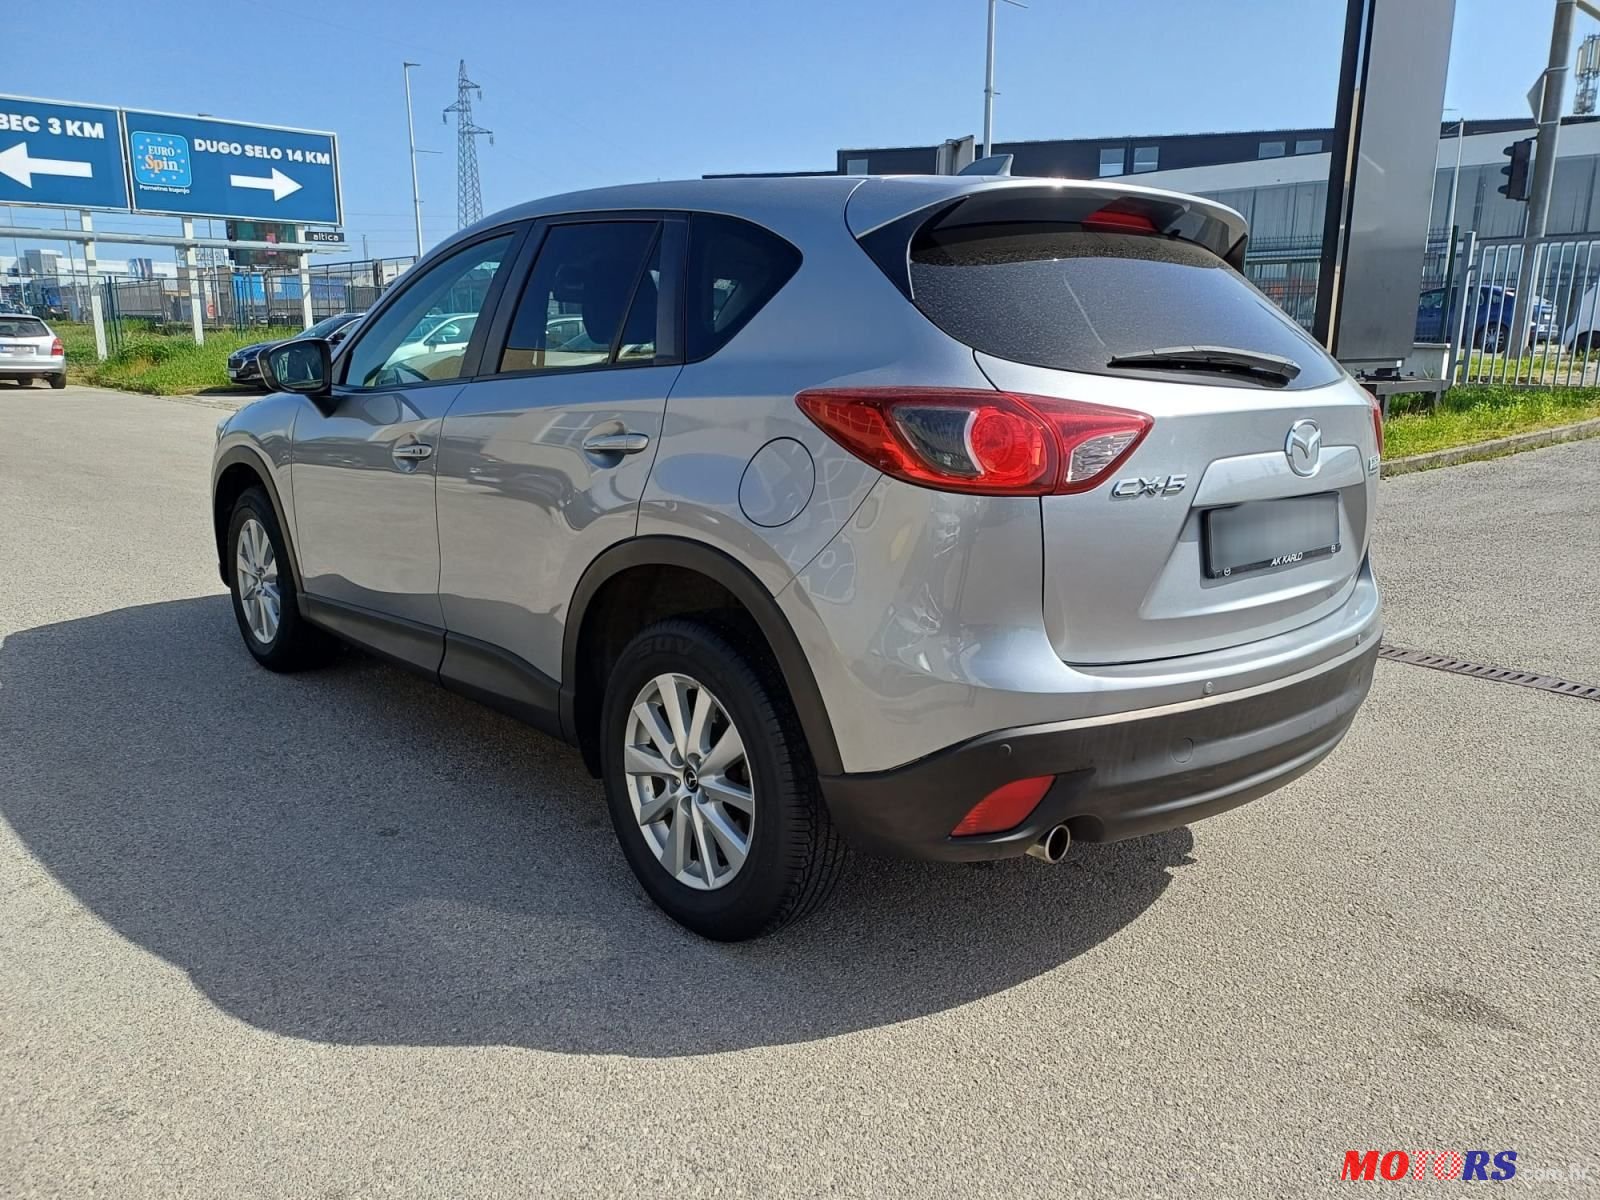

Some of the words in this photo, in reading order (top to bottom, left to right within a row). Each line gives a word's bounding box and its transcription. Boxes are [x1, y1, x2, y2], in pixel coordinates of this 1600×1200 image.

[47, 117, 62, 135] 3
[65, 119, 105, 139] KM
[148, 145, 175, 157] EURO
[194, 138, 242, 156] DUGO
[244, 144, 283, 160] SELO
[285, 149, 303, 162] 14
[305, 151, 331, 165] KM
[144, 154, 178, 174] Spin
[312, 232, 339, 241] altica
[1110, 474, 1187, 498] CX-5
[1270, 557, 1281, 567] AK
[1281, 551, 1303, 565] KARLO
